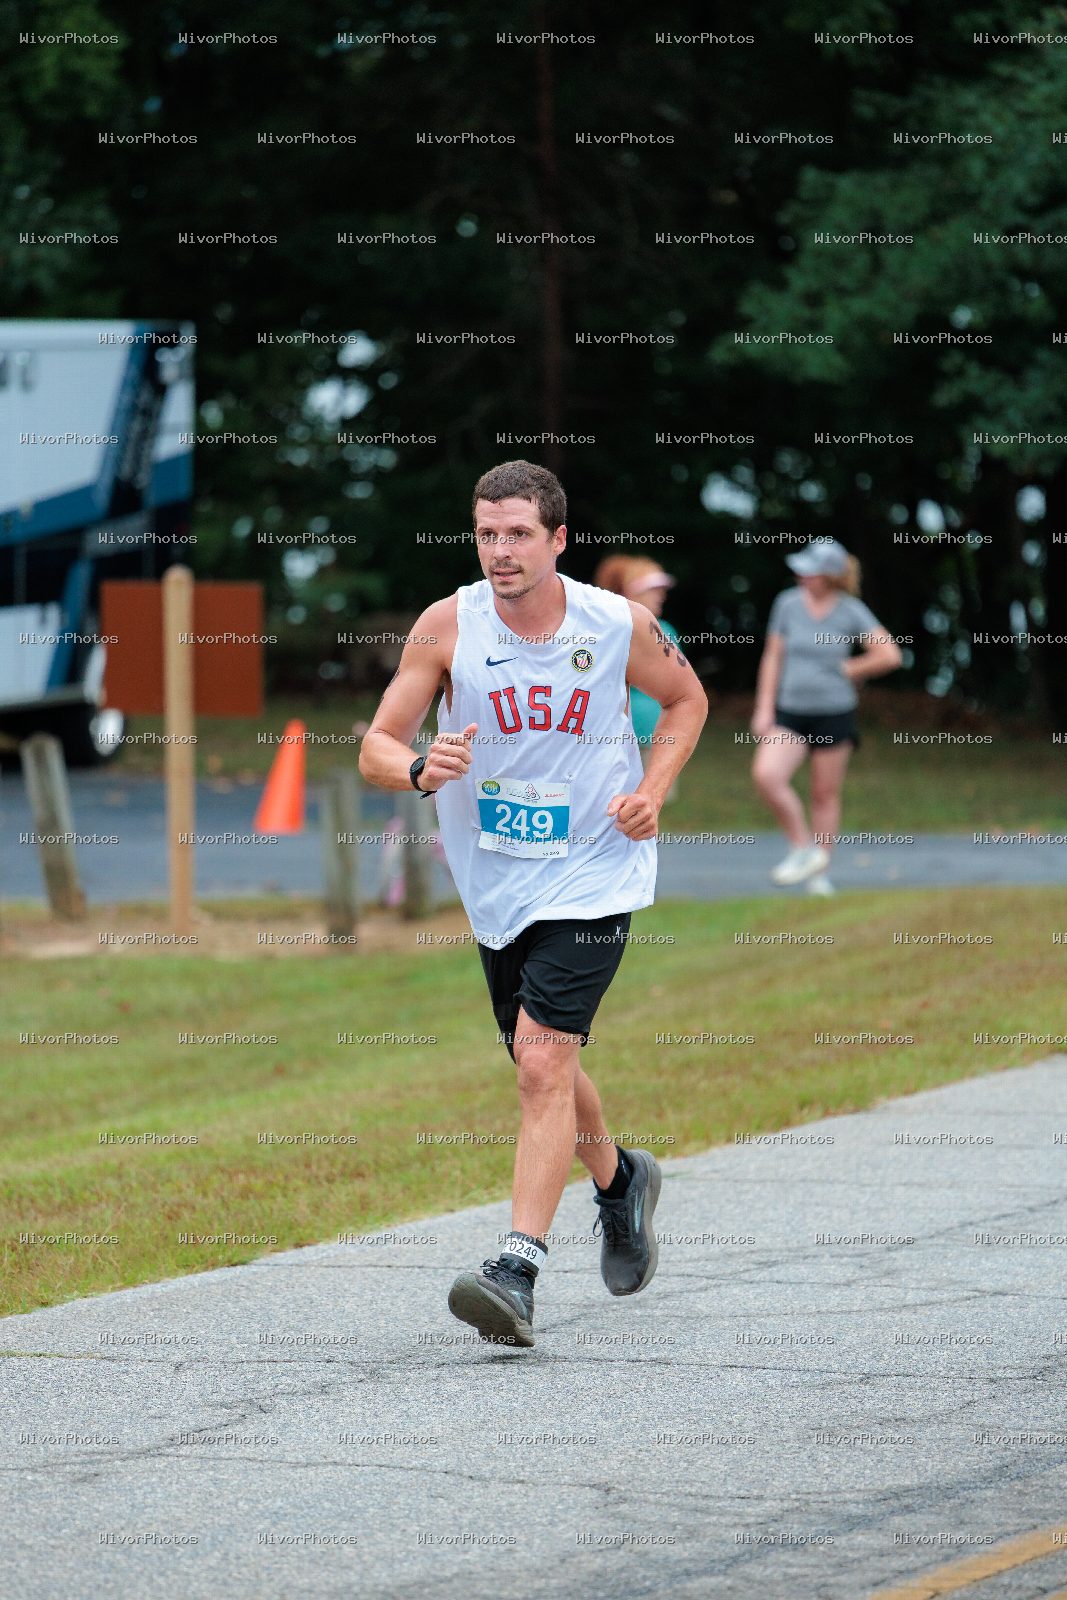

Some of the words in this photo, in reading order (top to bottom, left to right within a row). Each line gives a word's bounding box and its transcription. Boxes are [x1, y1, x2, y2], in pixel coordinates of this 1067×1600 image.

[488, 685, 591, 736] USA
[495, 803, 554, 841] 249
[508, 1240, 538, 1260] 0249
